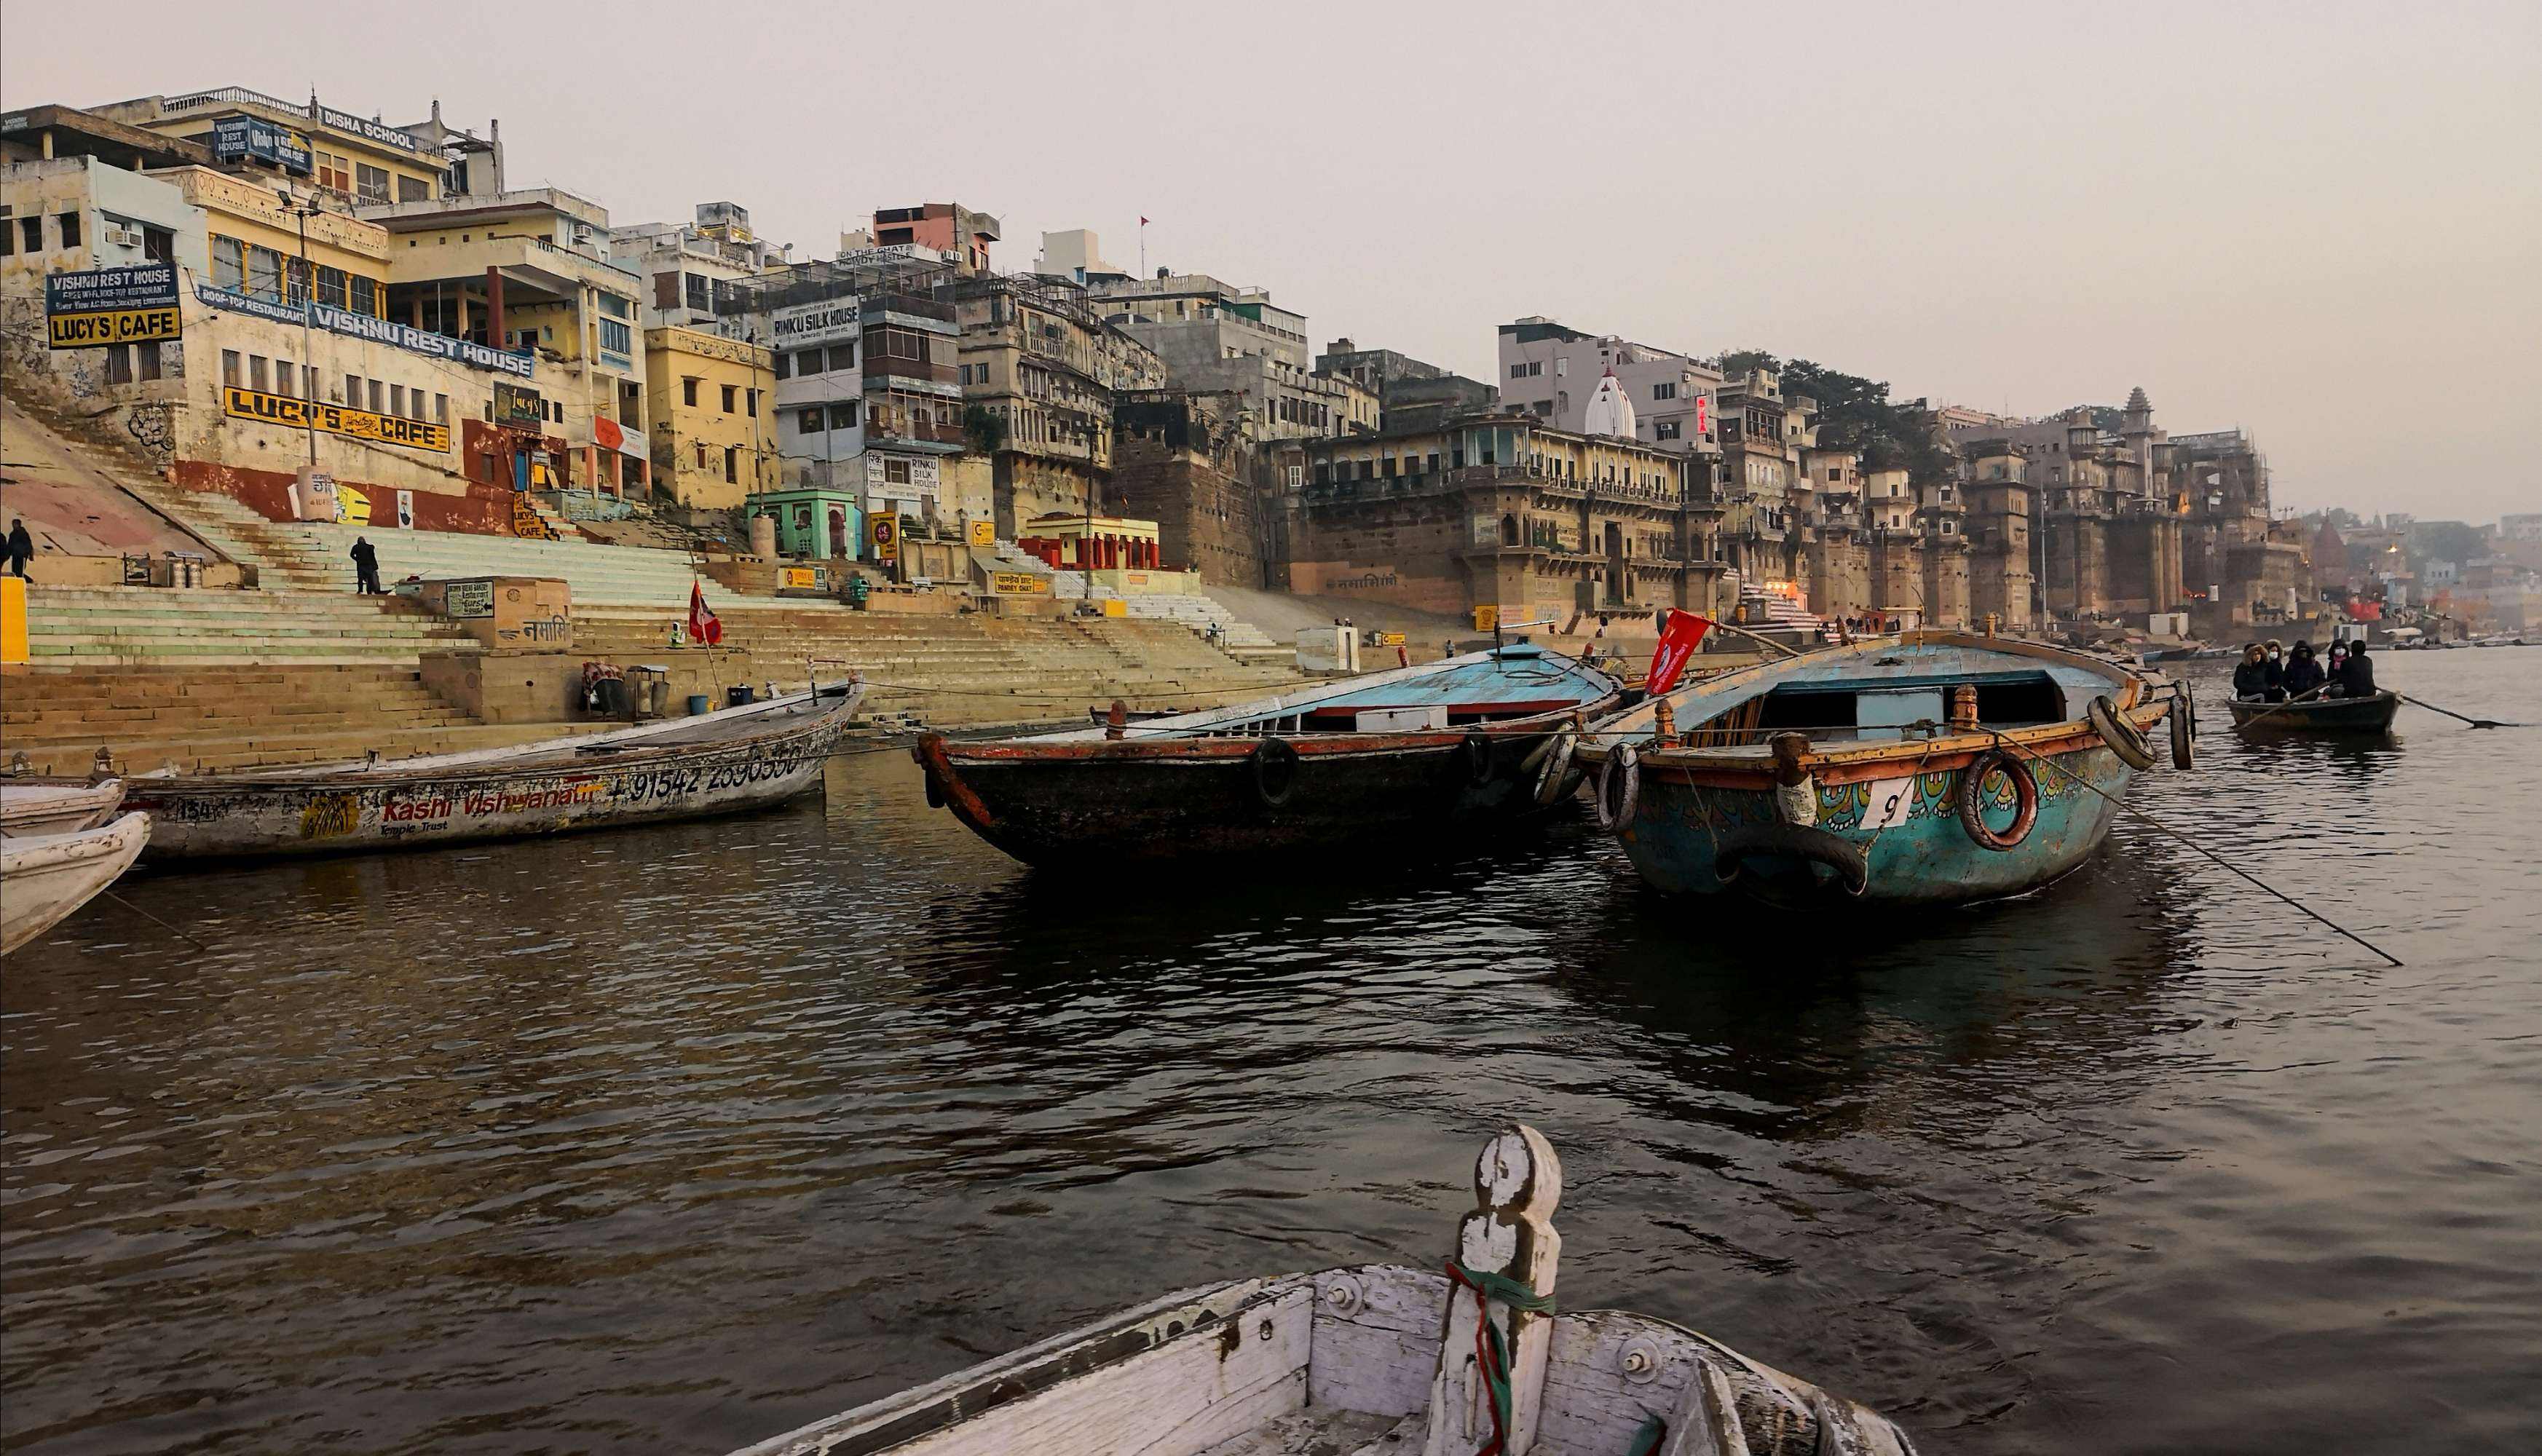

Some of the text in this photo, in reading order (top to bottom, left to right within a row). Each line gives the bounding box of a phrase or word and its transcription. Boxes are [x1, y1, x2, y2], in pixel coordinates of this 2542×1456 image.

[216, 122, 248, 132] VISHNU
[325, 109, 414, 150] DISHA SCHOOL
[218, 141, 246, 151] HOUSE
[222, 132, 242, 143] REST
[279, 146, 305, 163] HOUSE
[855, 248, 874, 256] THE
[877, 245, 904, 254] GHAT
[53, 269, 170, 290] VISHNU REST HOUSE
[202, 288, 304, 323] ROOF-TOP RESTAURANT
[53, 312, 173, 341] LUCY'S CAFE
[774, 316, 804, 336] RINKU
[805, 312, 829, 331] SILK
[830, 306, 858, 326] HOUSE
[315, 306, 532, 376] VISHNU REST HOUSE
[232, 391, 341, 429] LUCY'S
[380, 416, 436, 446] CAFE
[912, 459, 936, 470] RINKU
[914, 470, 933, 479] SILK
[914, 479, 938, 488] HOUSE
[521, 527, 540, 537] CAFE
[382, 797, 453, 823] Kashi
[1880, 794, 1899, 823] 9
[379, 820, 448, 837] Temple Trust
